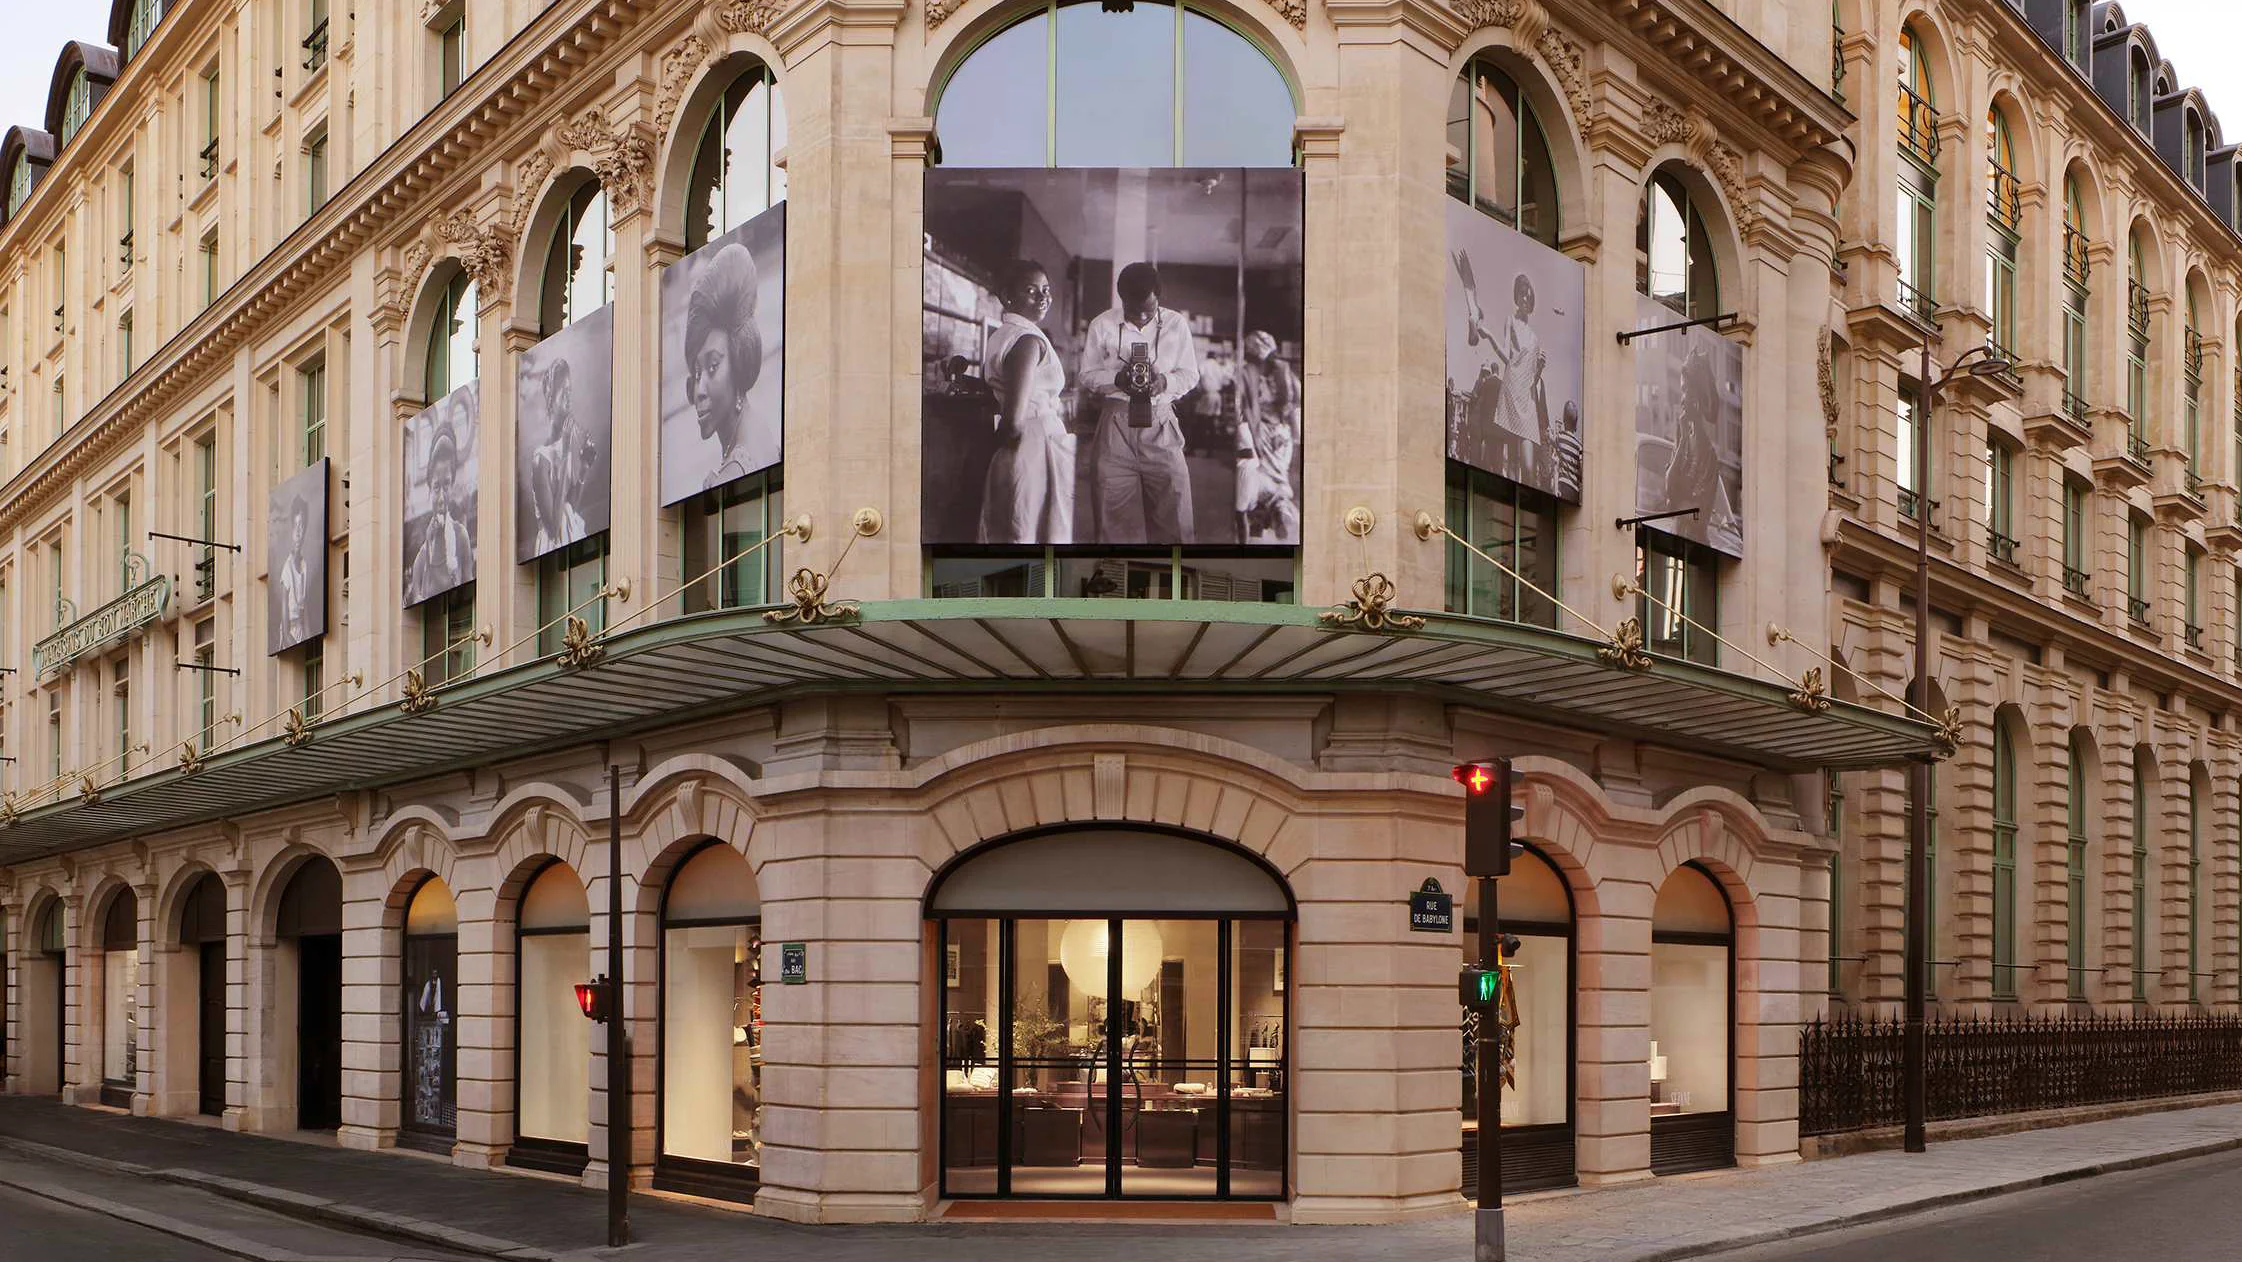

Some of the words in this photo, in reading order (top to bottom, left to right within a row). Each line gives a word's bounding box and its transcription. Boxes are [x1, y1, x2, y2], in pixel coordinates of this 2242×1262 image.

[84, 620, 97, 645] DU
[98, 611, 117, 637] BON
[1426, 900, 1437, 910] RUE
[1413, 913, 1421, 923] DE
[1422, 914, 1449, 925] BABYLONE
